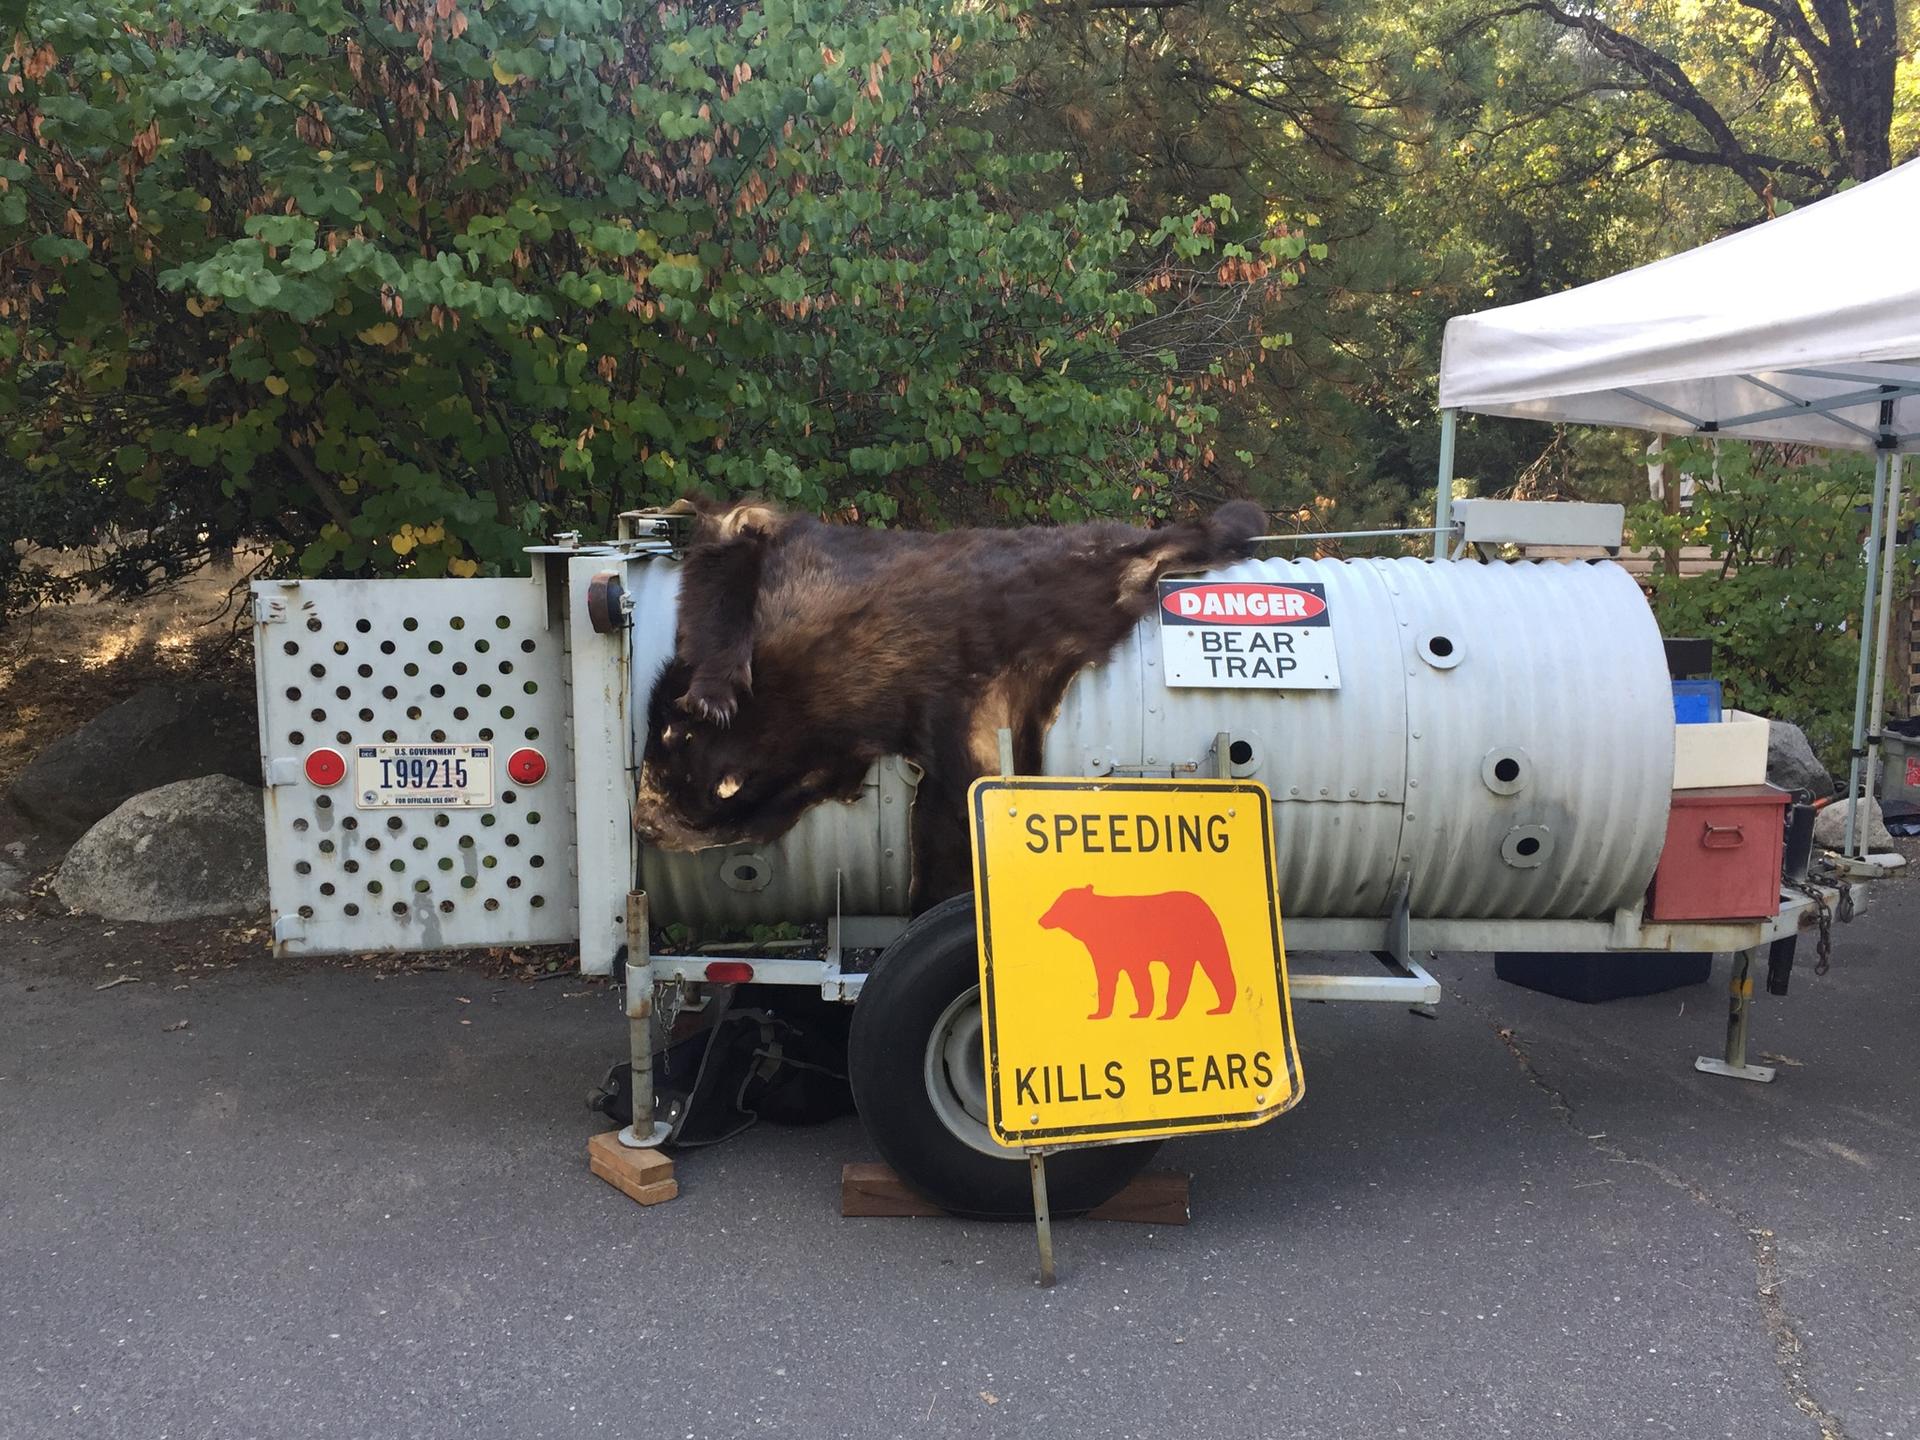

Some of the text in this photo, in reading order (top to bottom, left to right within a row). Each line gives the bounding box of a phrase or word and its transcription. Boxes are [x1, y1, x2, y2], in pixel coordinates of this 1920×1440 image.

[1179, 592, 1308, 617] DANGER
[1201, 631, 1296, 654] BEAR
[1203, 656, 1298, 679] TRAP
[395, 748, 456, 756] U.S. GOVERNMENT
[379, 758, 468, 789] I99215
[1025, 813, 1230, 854] SPEEDING
[1015, 1051, 1273, 1106] KILLS BEARS
